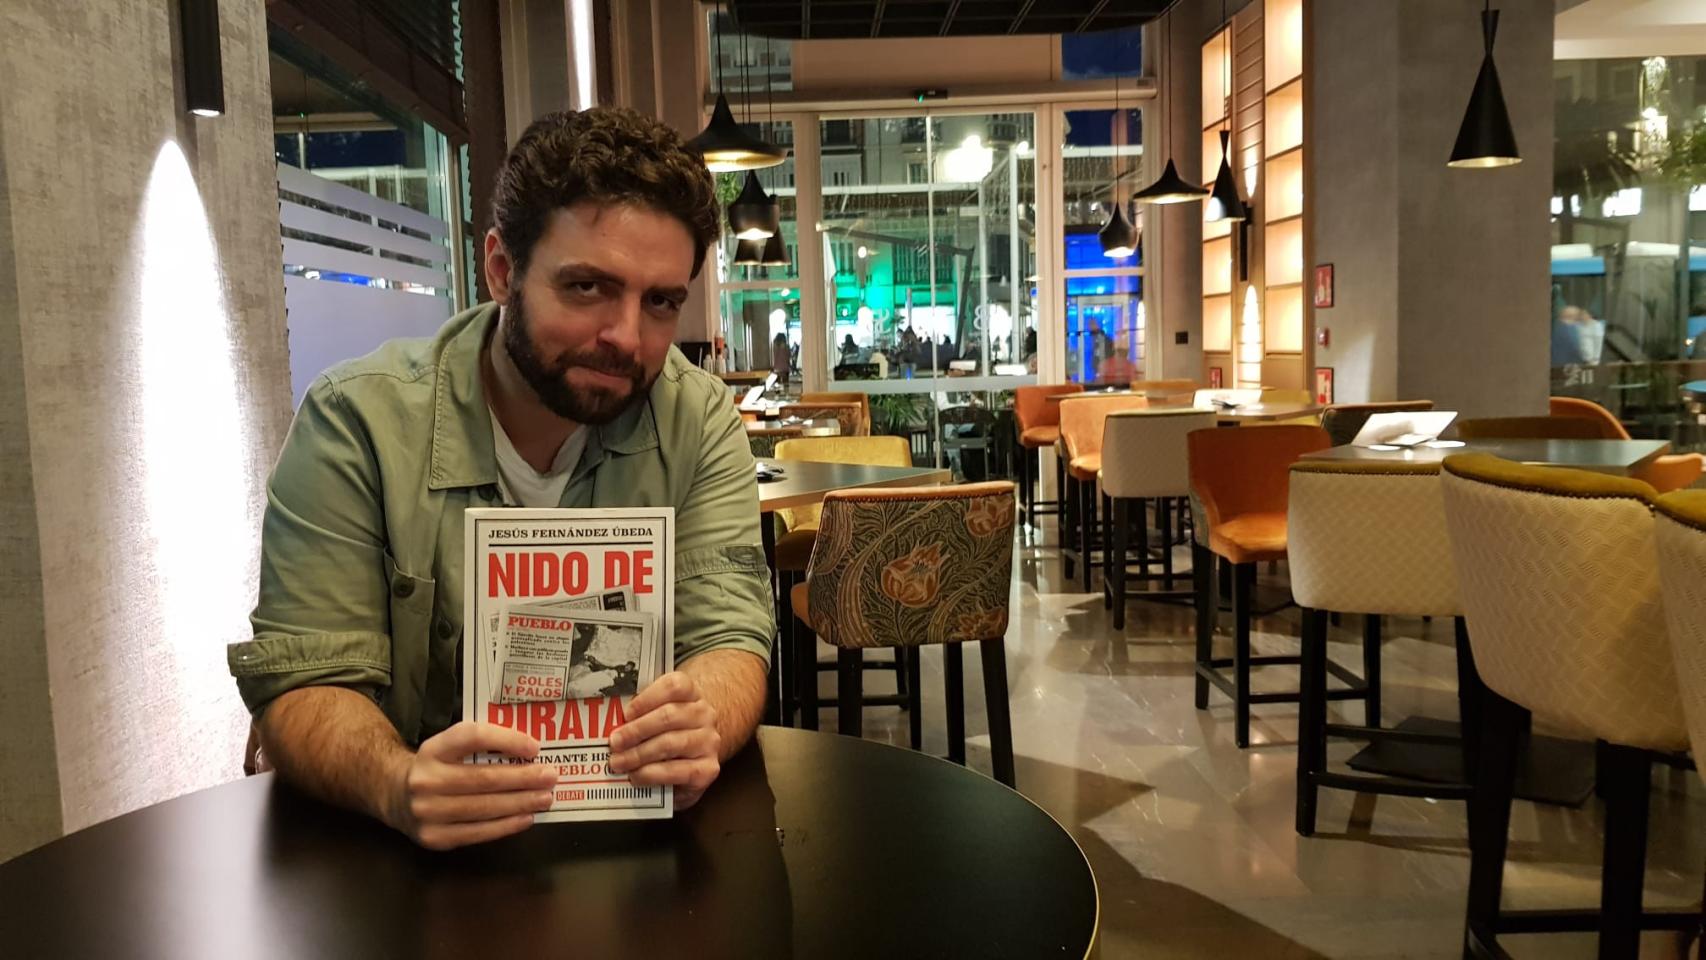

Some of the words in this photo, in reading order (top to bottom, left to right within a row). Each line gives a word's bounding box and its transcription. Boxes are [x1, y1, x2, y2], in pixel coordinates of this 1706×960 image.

[488, 528, 528, 539] JESÚS
[532, 527, 609, 538] FERNÁNDEZ
[612, 525, 653, 537] ÚBEDA
[488, 551, 589, 598] NIDO
[604, 550, 654, 595] DE
[507, 616, 572, 631] PUEBLO
[518, 675, 562, 687] GOLES
[504, 684, 512, 695] Y
[516, 686, 562, 698] PALOS
[487, 695, 626, 741] PIRATA
[556, 763, 601, 776] EBLO
[556, 790, 585, 800] DEBATE
